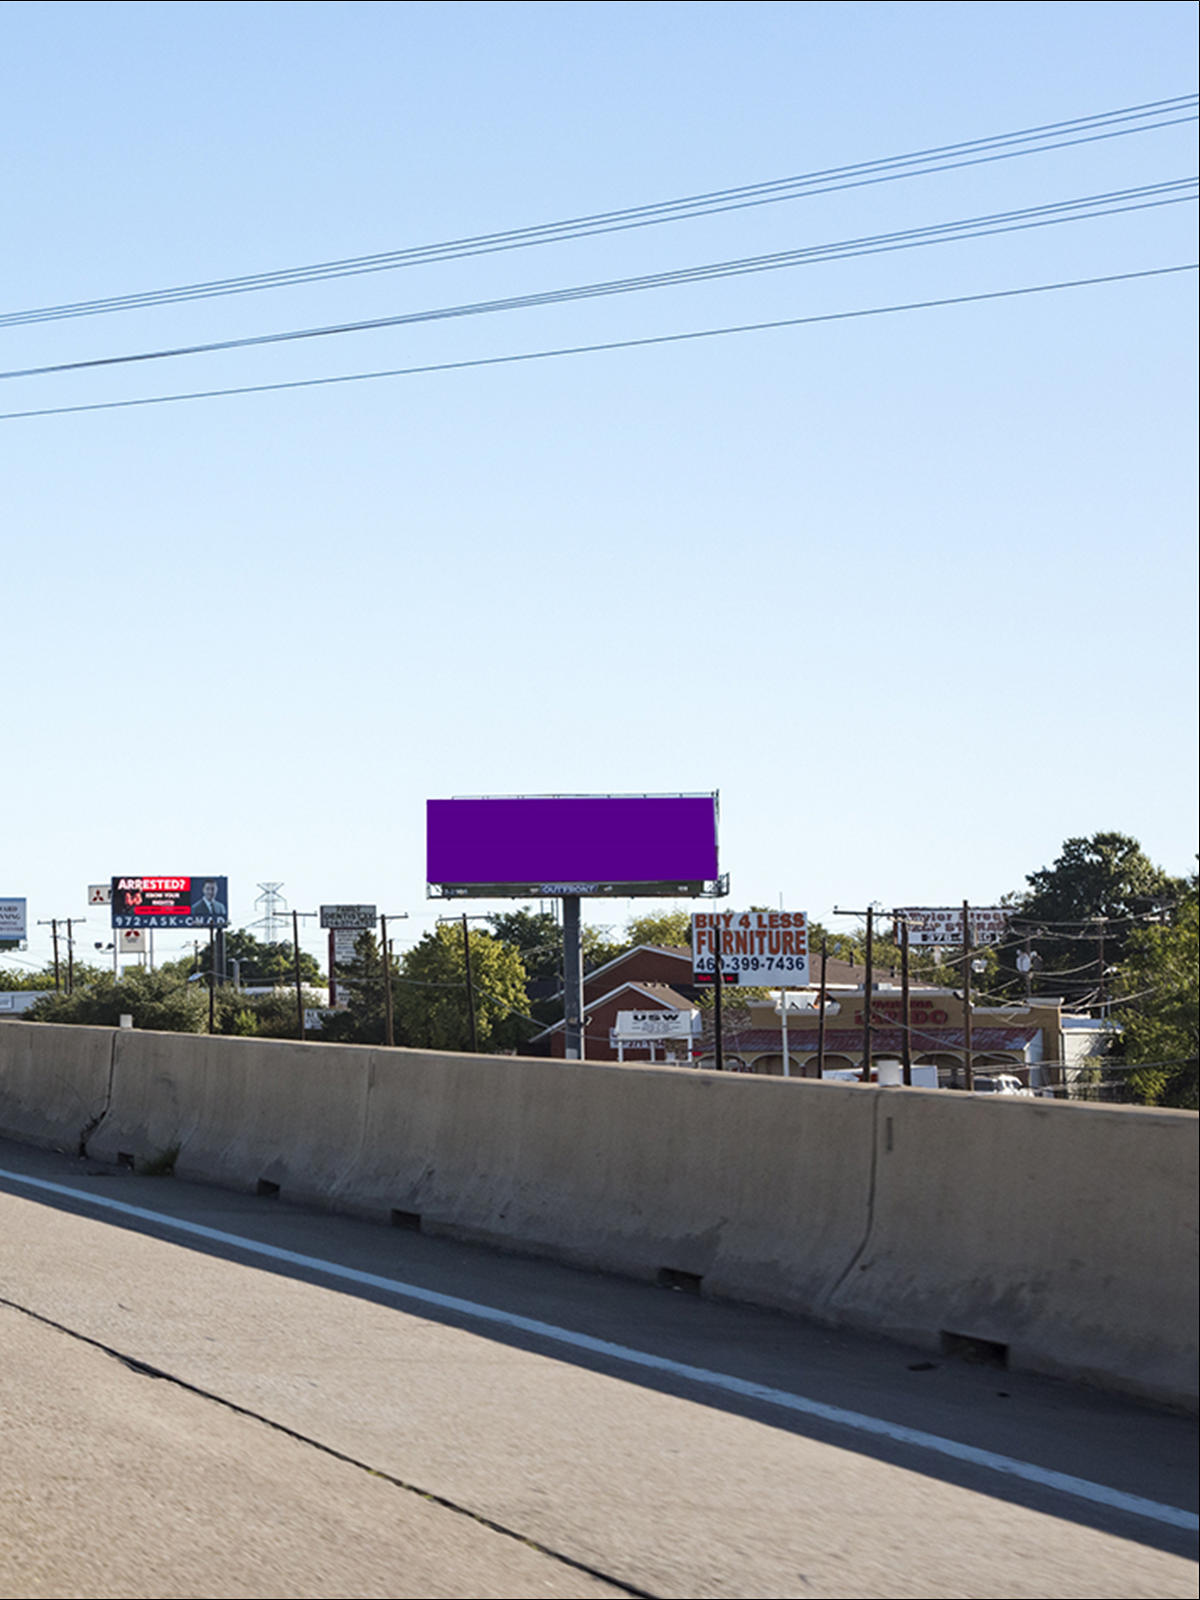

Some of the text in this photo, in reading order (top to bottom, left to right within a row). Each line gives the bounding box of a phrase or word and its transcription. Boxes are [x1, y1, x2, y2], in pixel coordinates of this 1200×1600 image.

[118, 879, 186, 890] ARRESTED?
[695, 912, 805, 929] BUY 4 LESS
[696, 930, 806, 955] FURNITURE
